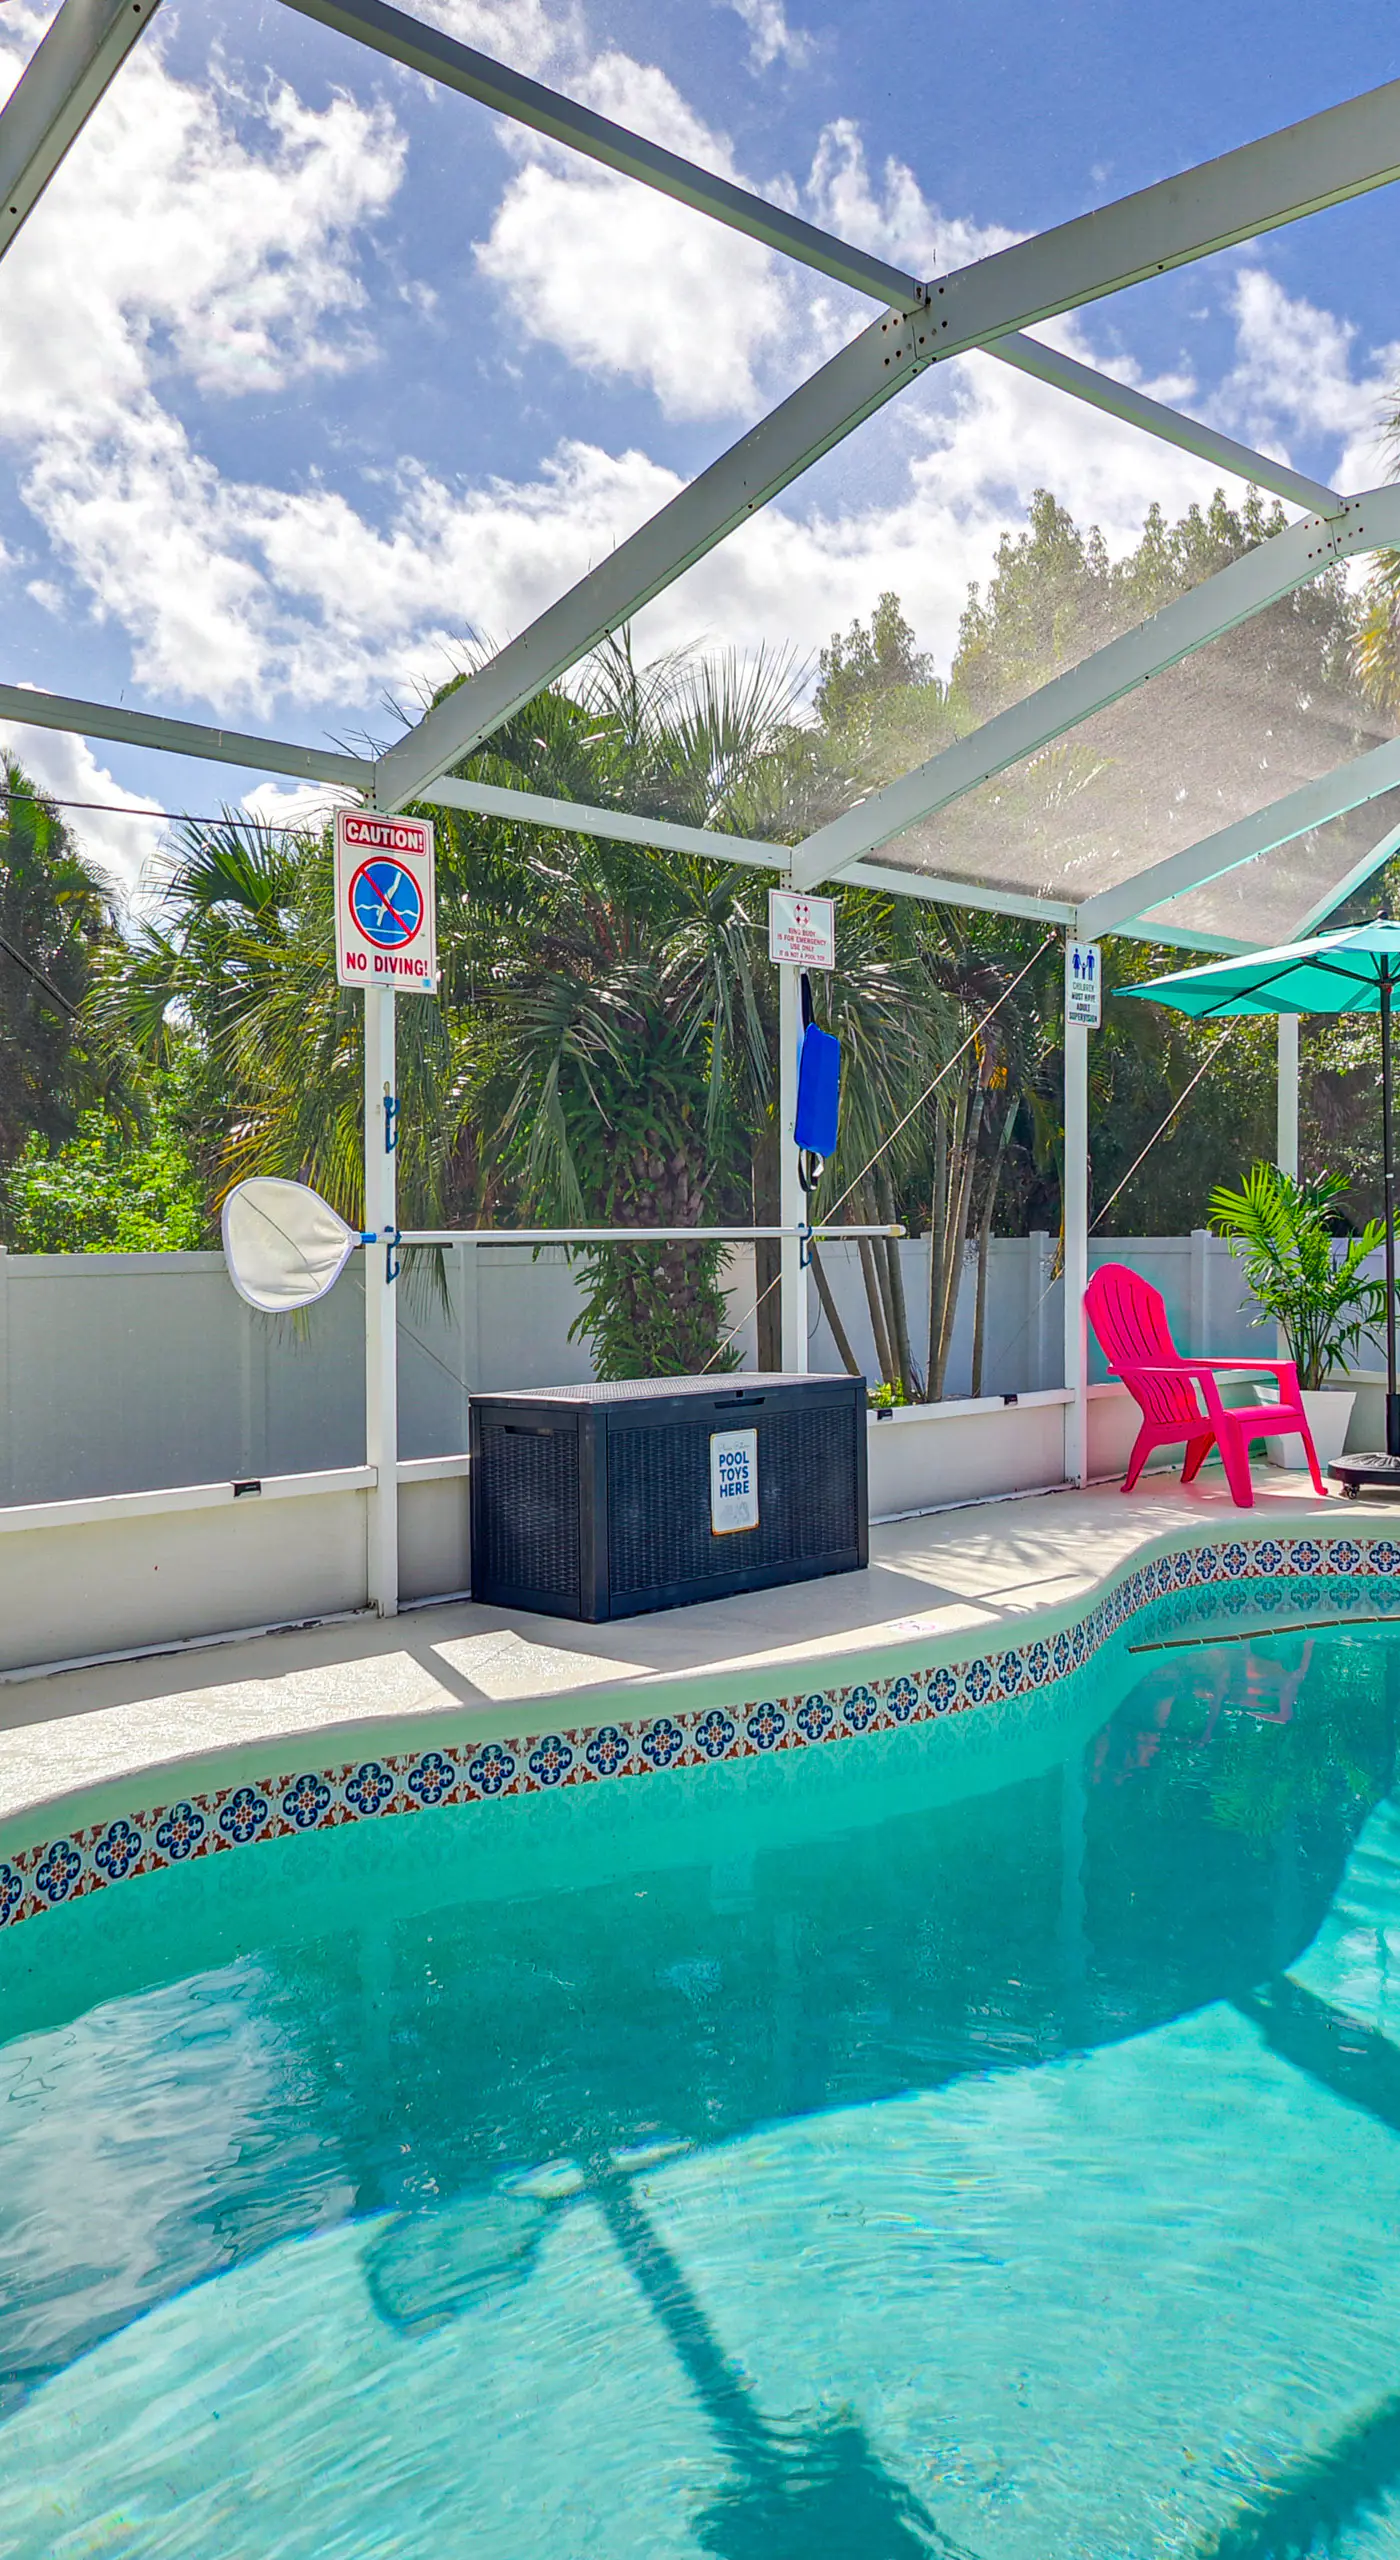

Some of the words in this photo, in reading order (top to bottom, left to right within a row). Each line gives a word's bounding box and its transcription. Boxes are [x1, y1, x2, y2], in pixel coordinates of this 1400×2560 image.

[346, 822, 424, 850] CAUTION!
[796, 936, 826, 946] EMERGENCY
[346, 952, 367, 971] NO
[374, 955, 428, 976] DIVING!
[1072, 982, 1095, 992] CHILDREN
[1071, 992, 1083, 1001] MUST
[1084, 994, 1096, 1003] HAVE
[1076, 1002, 1090, 1012] ADULT
[1069, 1011, 1097, 1022] SUPERVISION
[719, 1451, 749, 1467] POOL
[719, 1465, 749, 1482] TOYS
[720, 1480, 750, 1498] HERE
